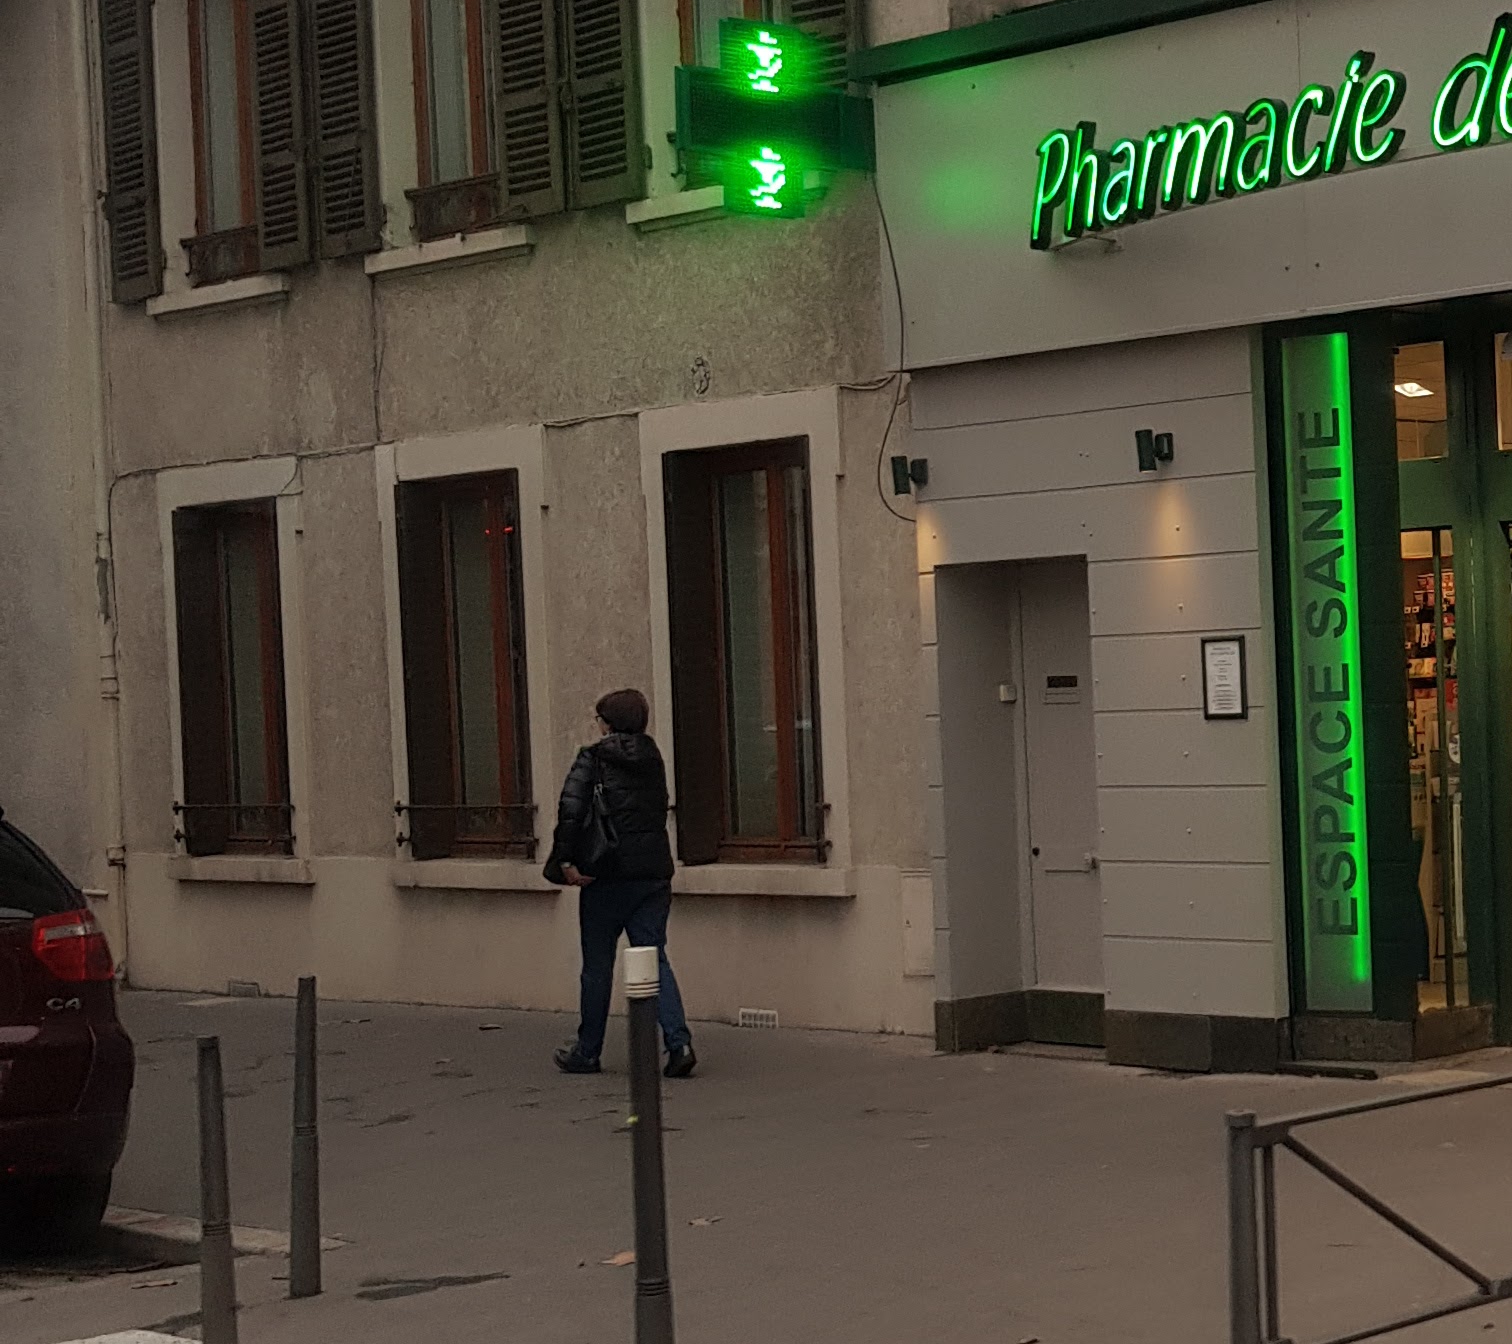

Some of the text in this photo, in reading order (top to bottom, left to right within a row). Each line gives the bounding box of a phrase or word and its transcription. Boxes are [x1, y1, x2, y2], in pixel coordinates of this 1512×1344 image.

[1030, 50, 1406, 250] Pharmacie
[1298, 407, 1359, 936] ESPACE SANTE
[46, 997, 80, 1011] C4
